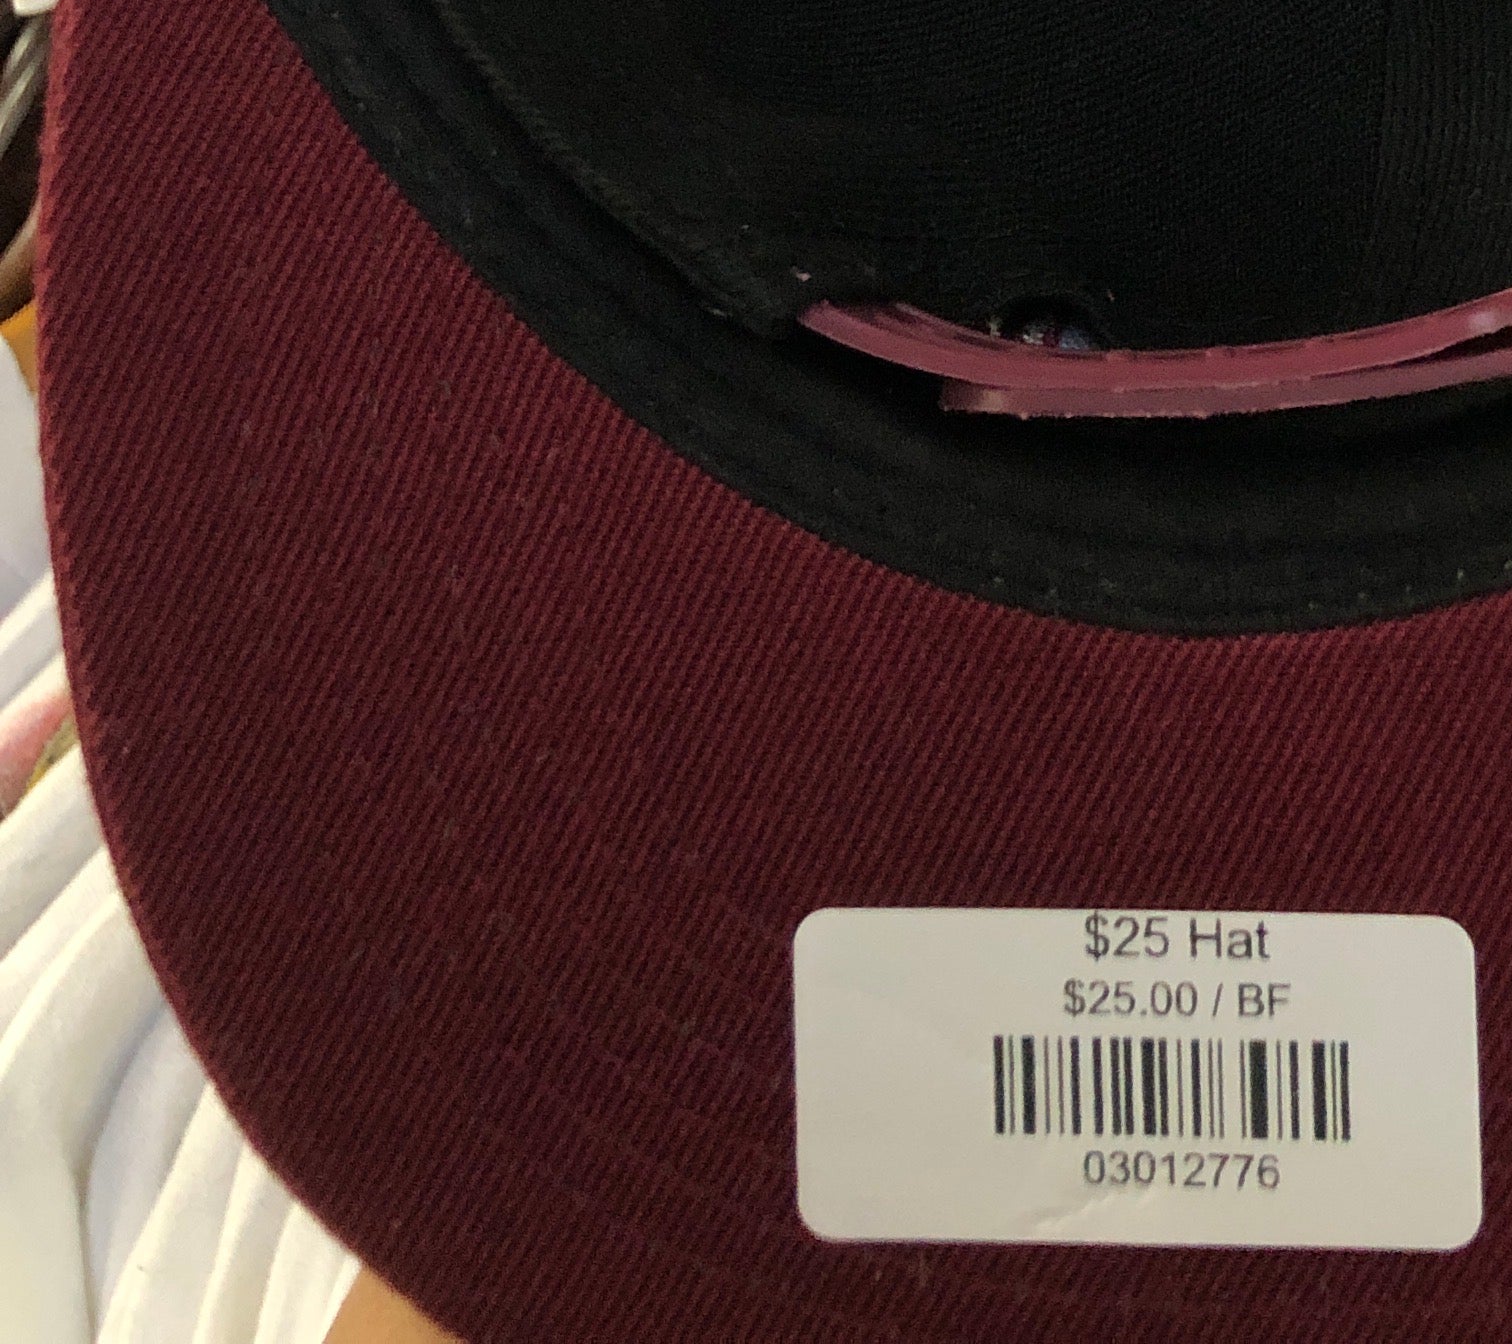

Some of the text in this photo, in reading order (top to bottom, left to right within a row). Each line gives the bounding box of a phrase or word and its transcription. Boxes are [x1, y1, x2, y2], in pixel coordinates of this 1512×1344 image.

[1083, 911, 1272, 963] $25 Hat
[1062, 979, 1292, 1018] $25.00 / BF
[1082, 1150, 1280, 1191] 03012776
